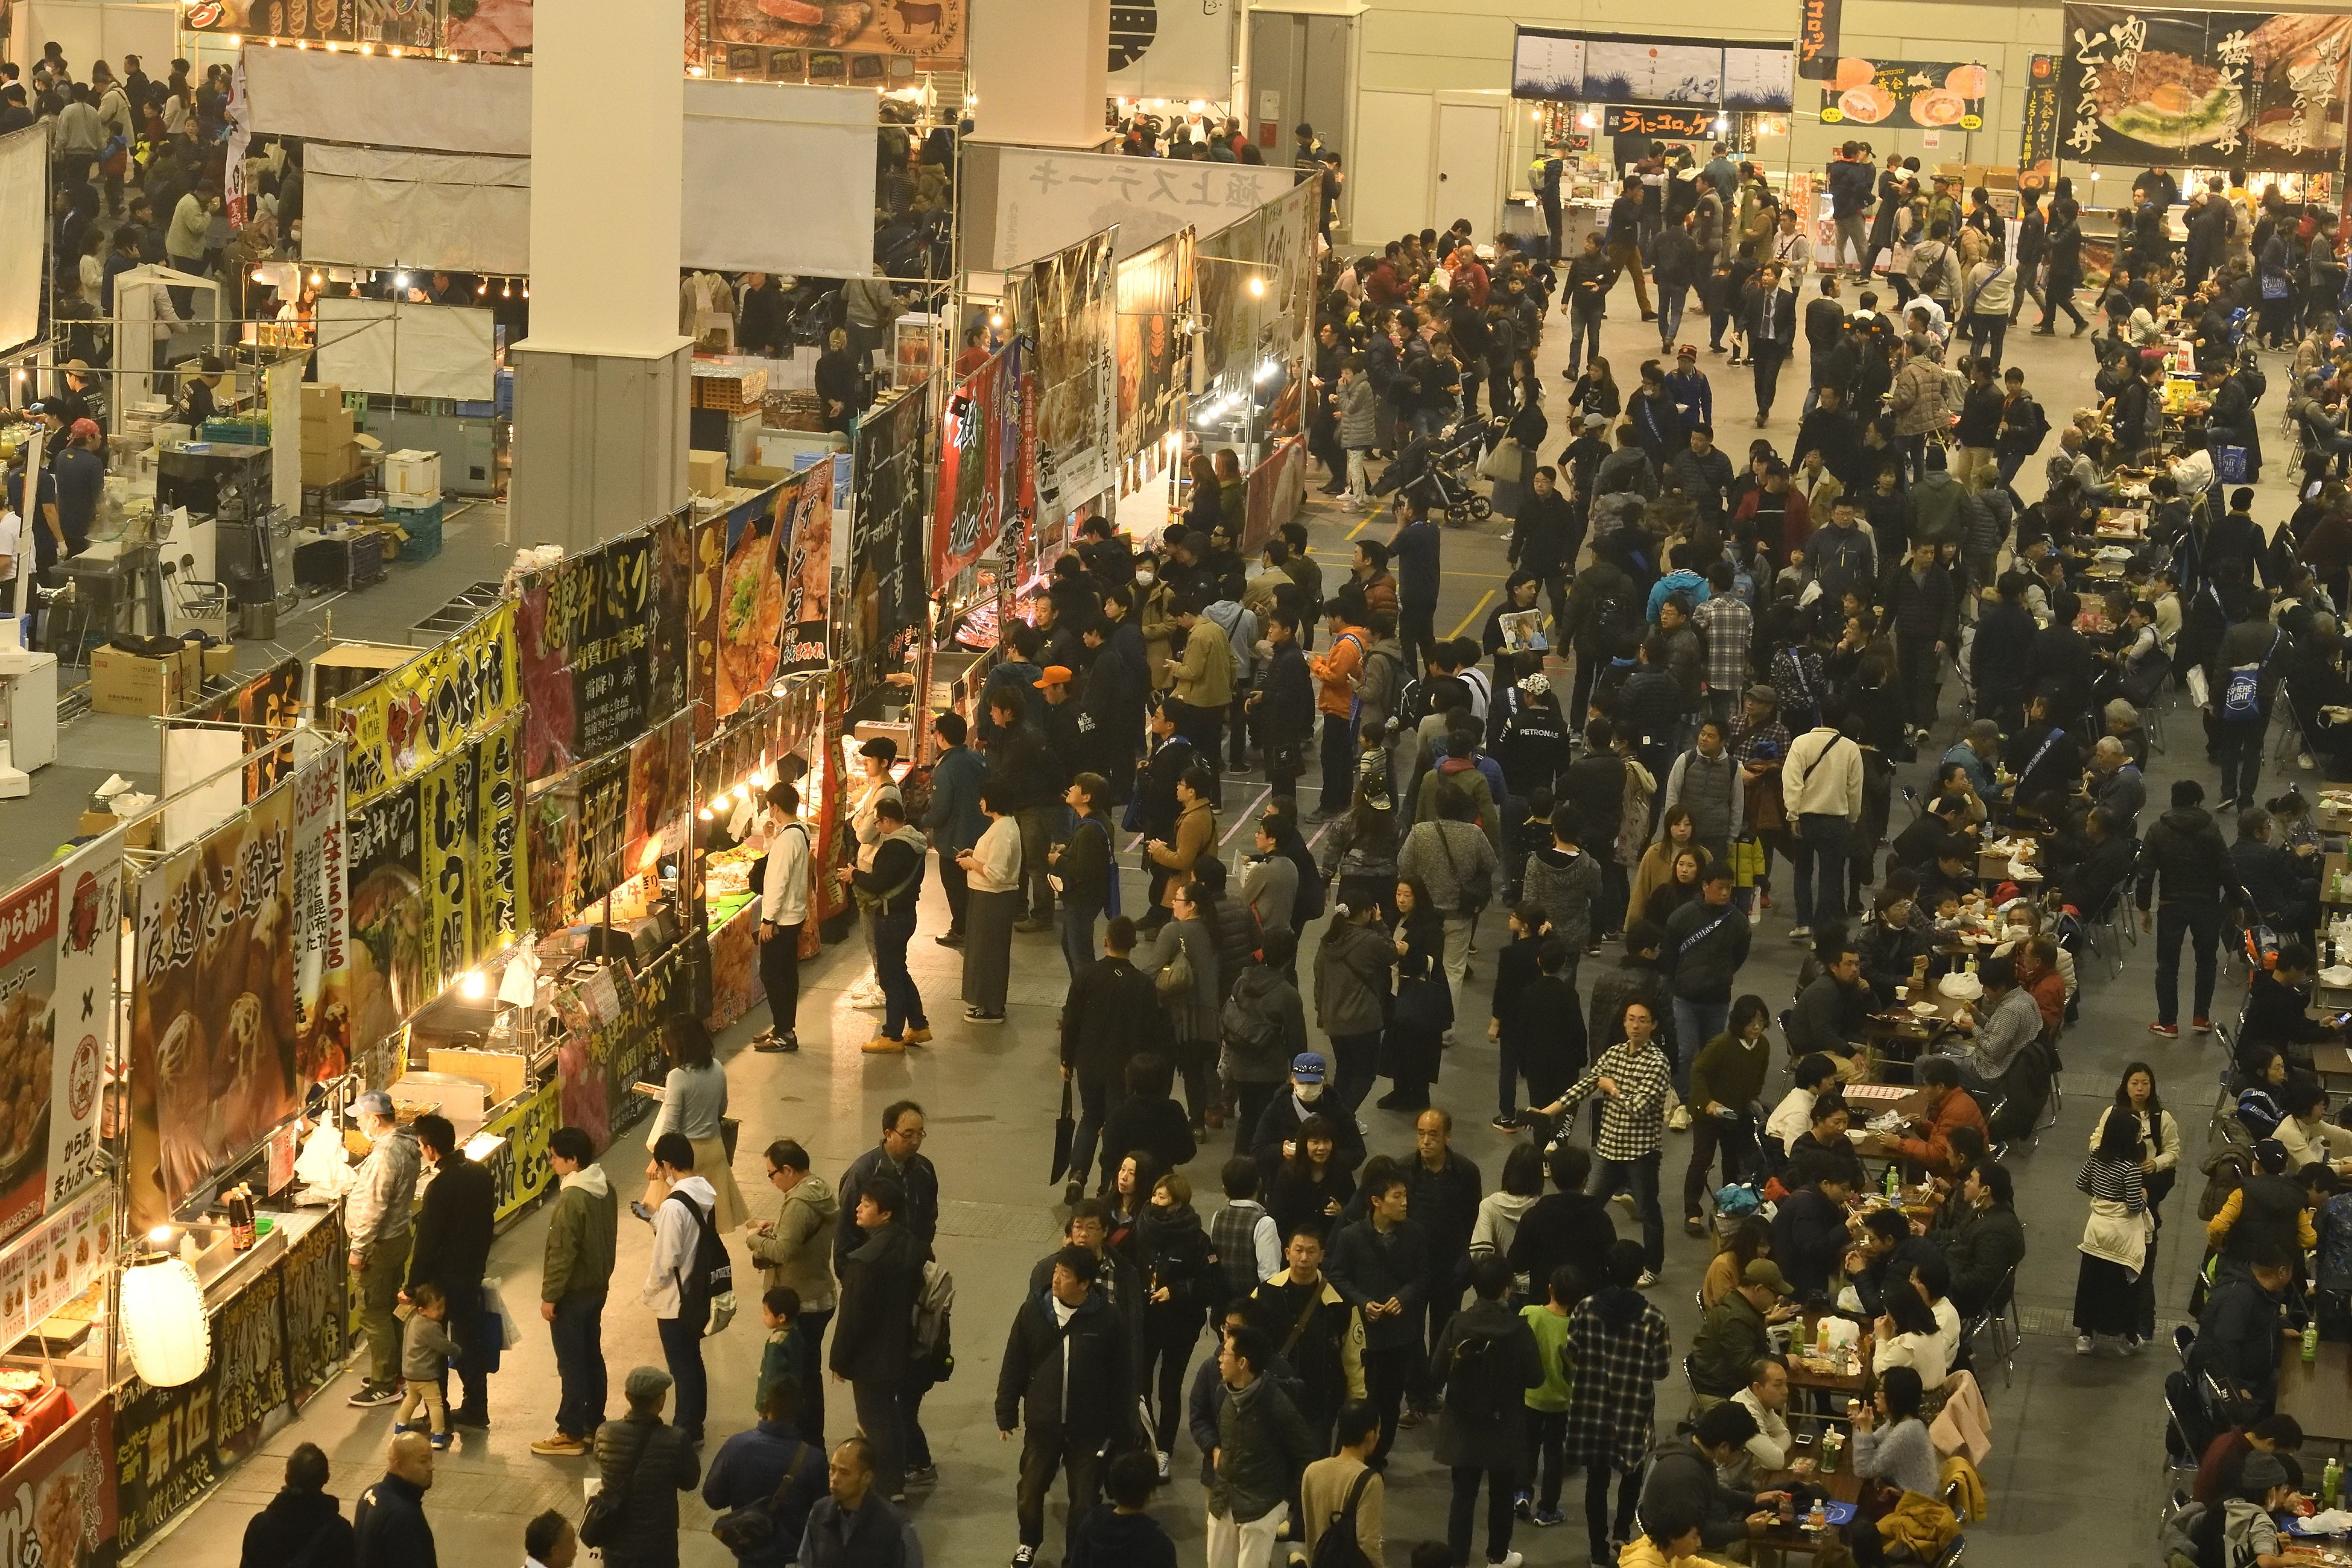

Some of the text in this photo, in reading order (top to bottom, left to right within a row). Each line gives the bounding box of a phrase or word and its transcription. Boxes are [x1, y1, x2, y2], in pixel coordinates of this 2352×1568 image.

[920, 22, 957, 55] STEAK
[1803, 1, 1825, 61] コロッケ
[1876, 77, 1905, 91] 黄金
[2311, 33, 2342, 107] 明太子
[2066, 28, 2107, 154] とろろ丼
[2212, 30, 2252, 156] 梅とろろ丼
[1619, 110, 1715, 136] うにコロッケ
[2280, 66, 2313, 156] とろろ丼
[784, 493, 818, 625] ザンギ
[584, 672, 615, 701] 霜降り
[2231, 692, 2250, 702] LIGHT
[362, 719, 380, 741] 専門店
[1520, 728, 1559, 739] PETRONAS
[1556, 1113, 1575, 1139] PUMA
[63, 1126, 95, 1164] からあ
[53, 1149, 95, 1203] まんぷく
[147, 1386, 211, 1490] 第1位
[121, 1451, 142, 1485] 部門
